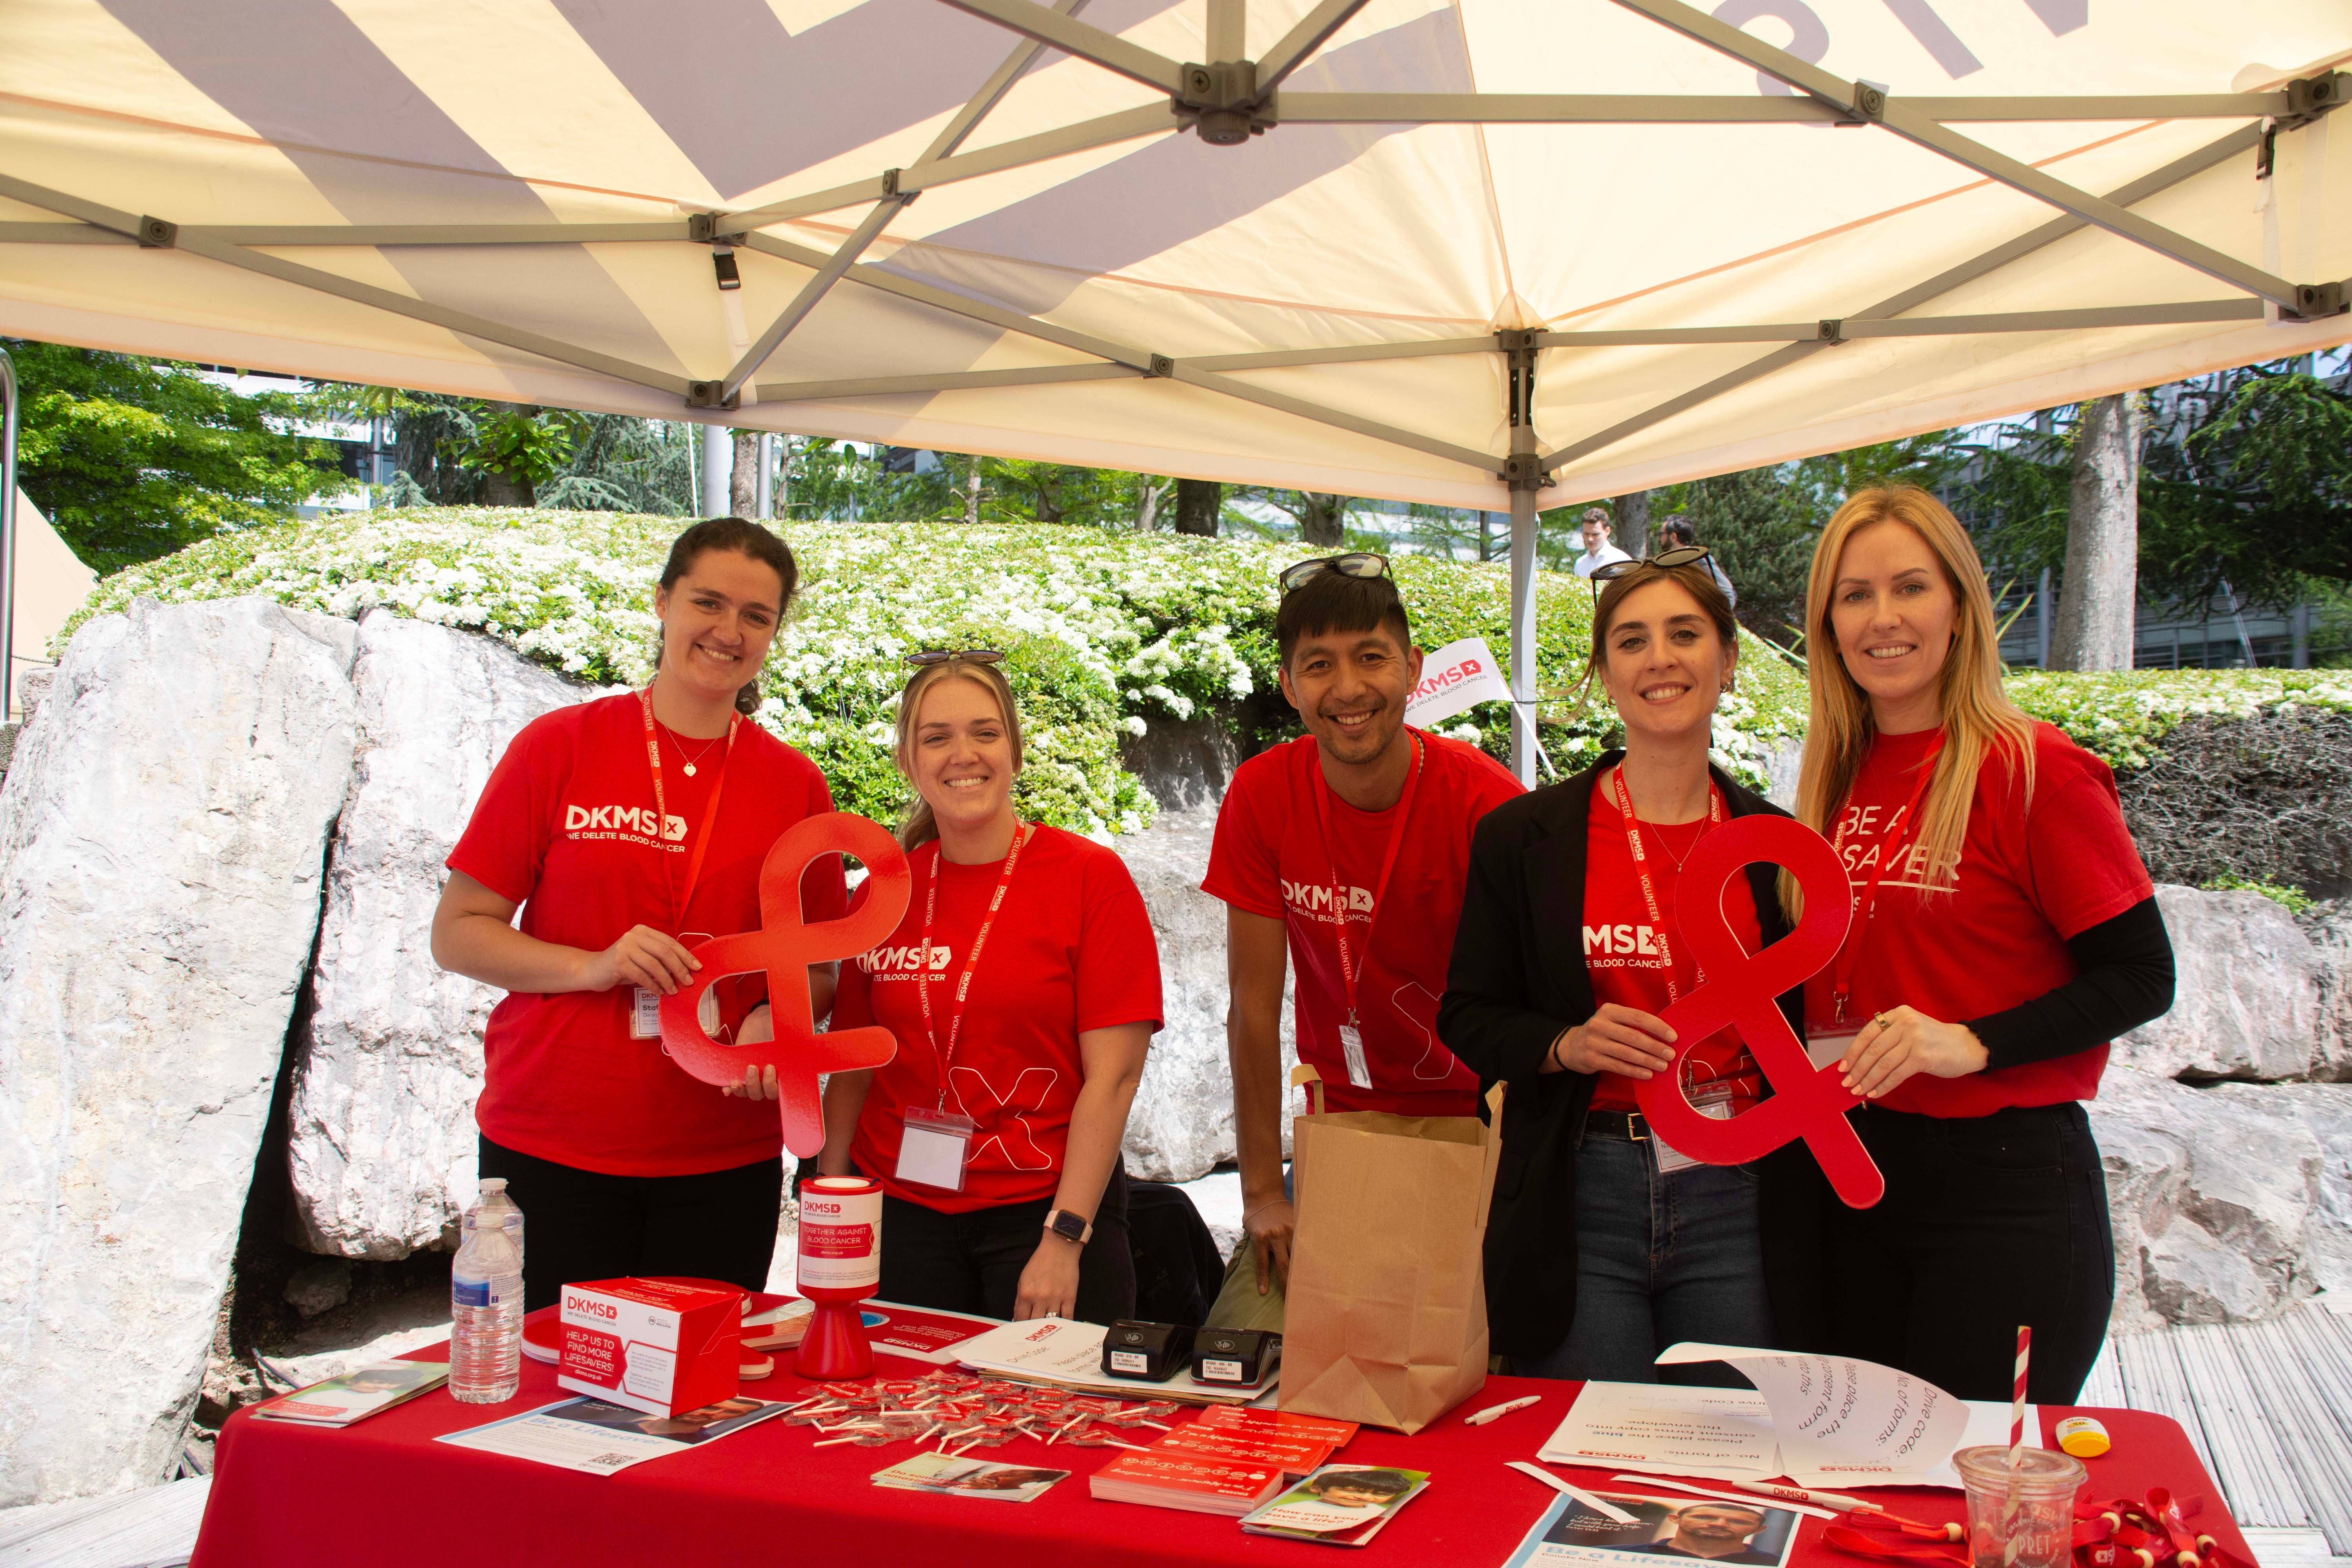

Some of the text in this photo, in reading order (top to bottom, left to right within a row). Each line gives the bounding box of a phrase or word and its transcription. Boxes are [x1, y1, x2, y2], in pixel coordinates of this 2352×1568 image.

[1417, 695, 1439, 706] DELETE
[1440, 684, 1461, 696] BLOOD
[1463, 675, 1487, 686] CANCER
[644, 695, 653, 731] VOLUNTEER
[650, 741, 659, 762] DKMS
[655, 779, 665, 820] VOLUNTEER
[1615, 778, 1632, 818] VOLUNTEER
[565, 805, 658, 835] DKMS
[1844, 806, 1882, 835] BE
[566, 832, 580, 840] WE
[620, 833, 649, 846] BLOOD
[650, 840, 685, 853] CANCER
[1630, 829, 1642, 854] DKMS
[1834, 828, 1844, 851] DKMS
[1004, 837, 1022, 875] VOLUNTEER
[1843, 844, 1962, 881] SAVER
[994, 886, 1007, 905] DKMS
[1281, 878, 1348, 912] DKMS
[1641, 875, 1660, 922] VOLUNTEER
[925, 887, 935, 927] VOLUNTEER
[1292, 907, 1372, 924] DELETE CANCER
[1336, 897, 1344, 918] DKMS
[970, 922, 991, 961] VOLUNTEER
[1583, 924, 1636, 955] MS
[1657, 933, 1670, 959] DKMS
[857, 947, 921, 973] DKMS
[920, 943, 928, 964] DKMS
[1339, 937, 1352, 981] VOLUNTEER
[1593, 959, 1625, 968] BLOOD
[1627, 959, 1662, 969] CANCE
[960, 972, 971, 995] DKMS
[920, 973, 929, 1018] VOLUNTEER
[947, 1015, 960, 1060] VOLUNTEER
[804, 1201, 830, 1213] DKMS
[804, 1226, 835, 1235] TOGETHER
[615, 1289, 647, 1298] THANK
[568, 1296, 605, 1317] DKMS
[567, 1331, 614, 1349] HELP US TO
[896, 1340, 931, 1350] DKMS
[1025, 1328, 1050, 1341] DKMS
[568, 1341, 612, 1360] FIND MORE
[565, 1353, 614, 1372] LIFESAVERS!
[575, 1369, 602, 1381] dkms.org.uk
[1800, 1374, 1812, 1396] this
[1798, 1363, 1833, 1430] consent form
[1817, 1361, 1857, 1438] Please place the
[1876, 1374, 1910, 1446] No. of forms:
[1895, 1387, 1937, 1457] Drive code:
[573, 1425, 665, 1445] Lifesaver
[884, 1474, 931, 1485] amazing
[909, 1474, 969, 1485] something
[1774, 1487, 1800, 1499] DKMS
[1265, 1512, 1297, 1521] save
[1272, 1507, 1302, 1516] How
[2018, 1535, 2051, 1555] PRET
[1546, 1546, 1580, 1555] Be
[1613, 1554, 1733, 1568] Lifesav
